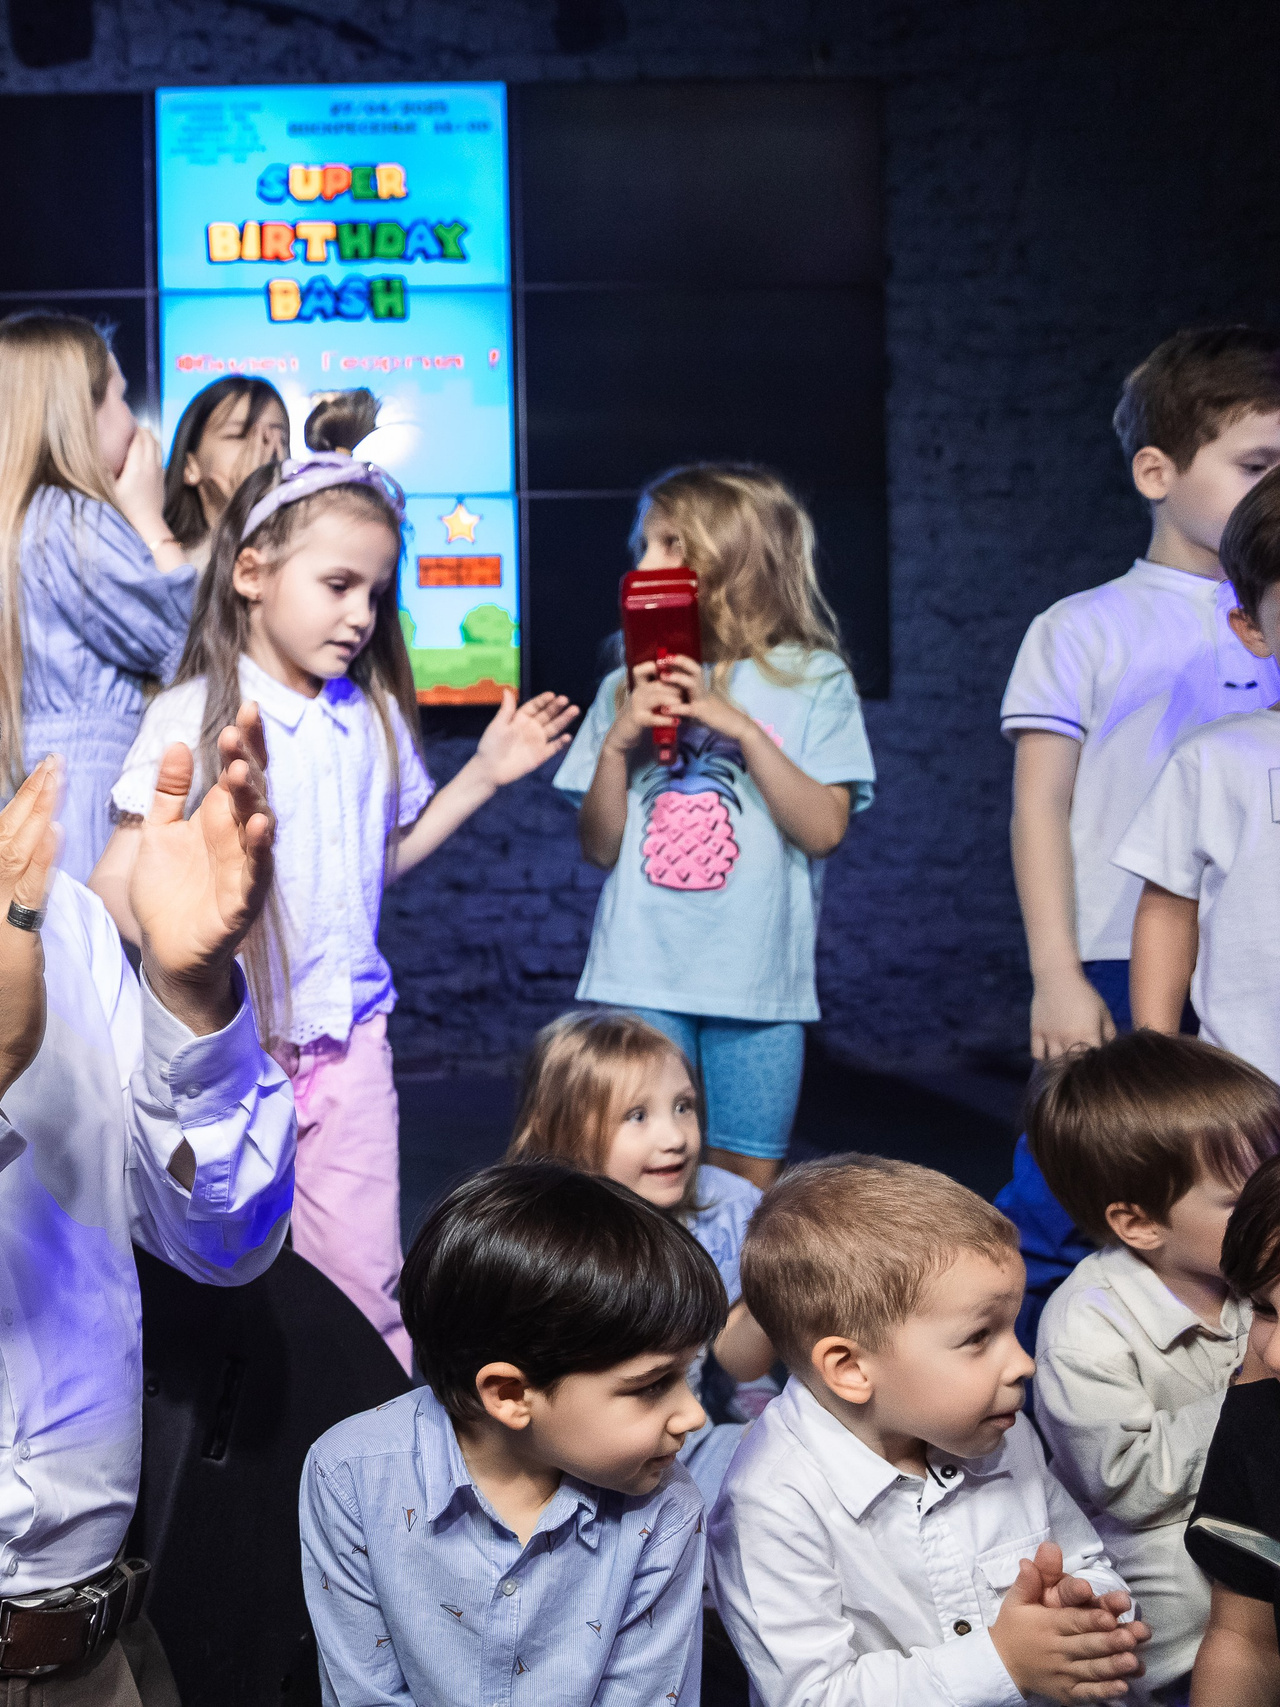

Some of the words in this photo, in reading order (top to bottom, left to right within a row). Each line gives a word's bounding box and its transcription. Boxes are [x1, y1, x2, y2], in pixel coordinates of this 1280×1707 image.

[257, 162, 408, 205] SUPER
[207, 218, 468, 264] BIRTHDAY
[266, 274, 409, 323] BASH
